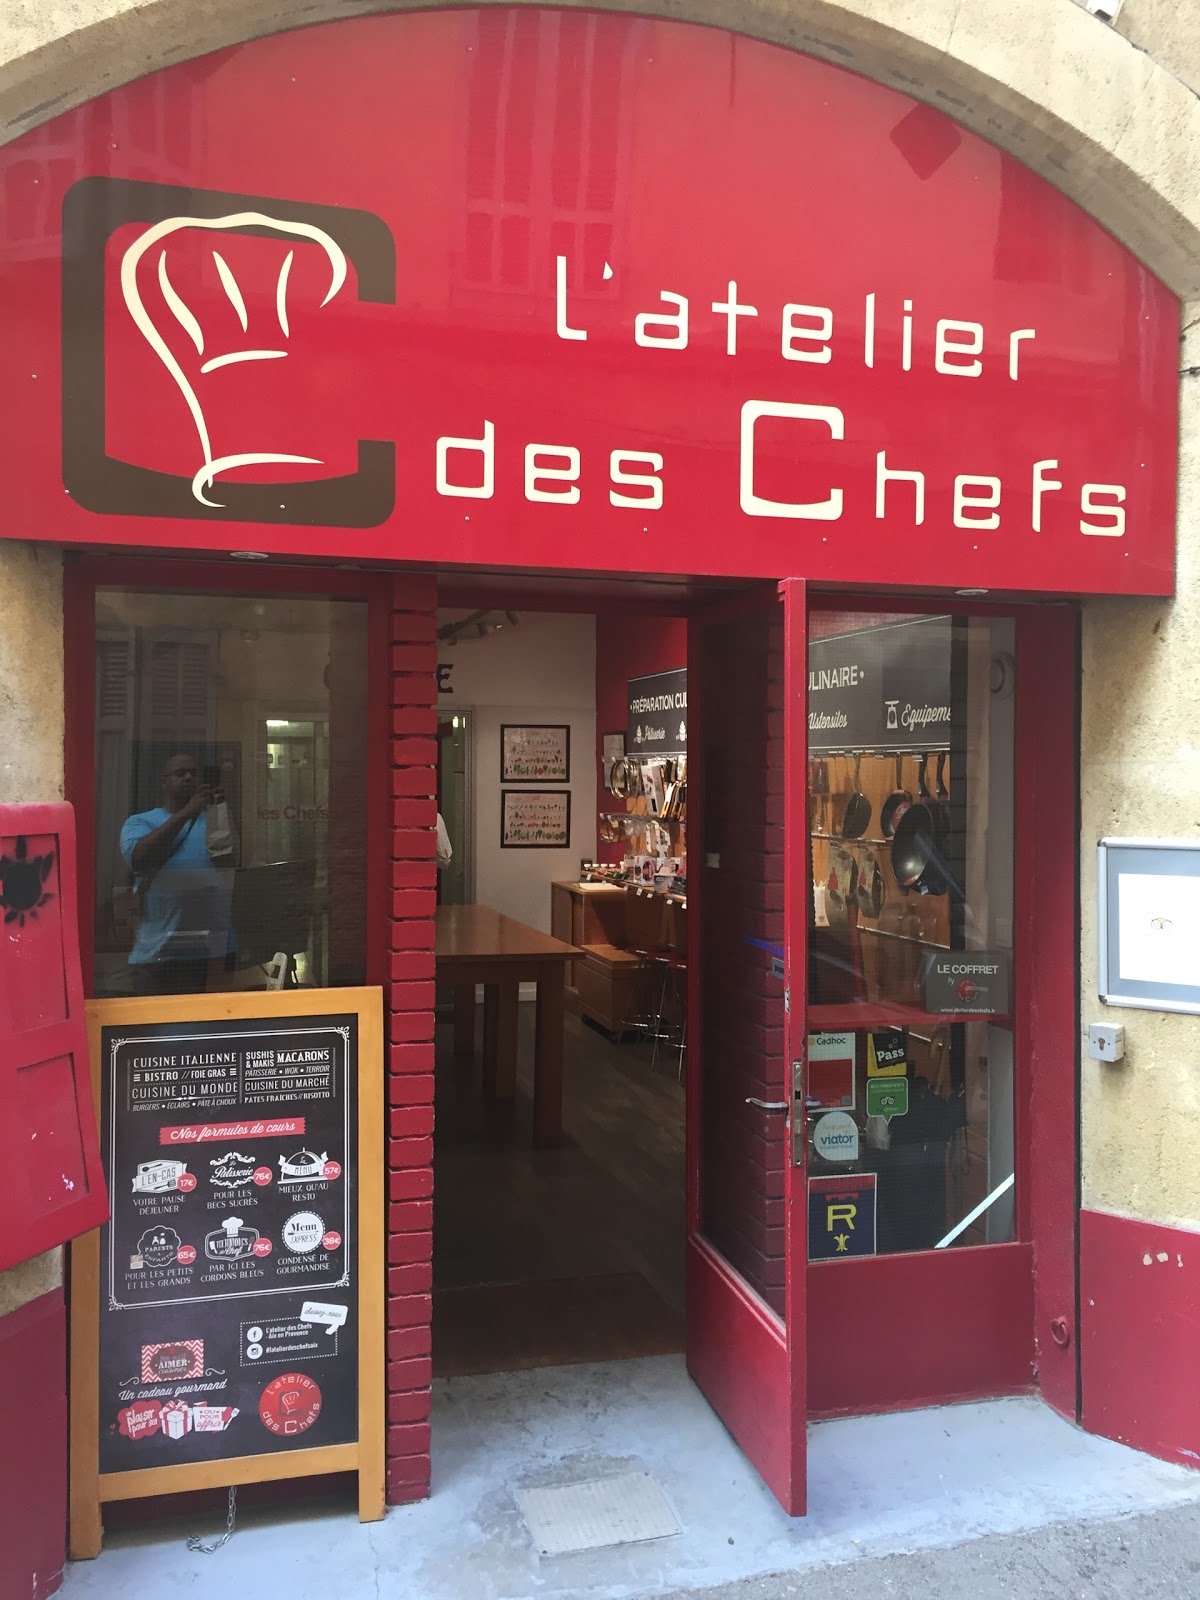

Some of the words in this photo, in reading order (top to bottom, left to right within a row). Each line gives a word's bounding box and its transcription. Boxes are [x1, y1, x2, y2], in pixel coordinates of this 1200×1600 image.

[556, 255, 1036, 381] L'atelier
[436, 419, 664, 510] des
[740, 399, 1127, 537] Chefs
[632, 695, 674, 713] PRÉPARATION
[937, 964, 950, 974] LE
[951, 964, 999, 975] COFFRET
[816, 1037, 846, 1046] Cadhoc
[133, 1056, 177, 1068] CUISINE
[181, 1052, 237, 1066] ITALIENNE
[245, 1050, 275, 1060] SUSHIS
[276, 1050, 330, 1064] MACARONS
[876, 1048, 905, 1062] Pass
[246, 1060, 251, 1069] &
[252, 1059, 275, 1068] MAKIS
[284, 1066, 299, 1075] WOK
[305, 1064, 330, 1074] TERROIR
[144, 1071, 179, 1082] BISTRO
[190, 1069, 206, 1079] FOIE
[207, 1068, 226, 1078] GRAS
[244, 1080, 279, 1092] CUISINE
[281, 1080, 293, 1089] DU
[296, 1076, 330, 1088] MARCHÉ
[132, 1086, 177, 1099] CUISINE
[181, 1084, 196, 1096] DU
[200, 1082, 238, 1095] MONDE
[303, 1091, 330, 1100] RISOTTO
[132, 1103, 160, 1112] BURGERS
[216, 1098, 237, 1106] CHOUX
[170, 1127, 197, 1140] Nos
[196, 1124, 249, 1142] formules
[250, 1122, 264, 1134] de
[266, 1122, 296, 1133] cours
[820, 1134, 854, 1145] viator
[255, 1172, 271, 1180] 76€
[324, 1166, 339, 1174] 57€
[142, 1167, 176, 1186] L'EN-CAS
[180, 1179, 194, 1187] 17€
[278, 1184, 302, 1194] MIEUX
[306, 1182, 329, 1192] QU'AU
[132, 1198, 158, 1206] VOTRE
[161, 1195, 186, 1204] PAUSE
[213, 1190, 234, 1200] POUR
[237, 1190, 252, 1198] LES
[292, 1193, 316, 1202] RESTO
[139, 1204, 180, 1216] DÉJEUNER
[207, 1200, 226, 1210] BECS
[827, 1204, 857, 1232] R
[291, 1223, 317, 1232] Menu
[291, 1234, 317, 1244] EXPRESS
[324, 1237, 340, 1245] 38€
[254, 1244, 270, 1252] 76€
[277, 1254, 317, 1266] CONDENSÉ
[320, 1253, 330, 1261] DE
[209, 1264, 225, 1272] PAR
[228, 1262, 238, 1270] ICI
[241, 1261, 256, 1269] LES
[276, 1262, 331, 1275] GOURMANDISE
[124, 1272, 146, 1281] POUR
[150, 1270, 164, 1278] LES
[167, 1267, 194, 1277] PETITS
[200, 1272, 237, 1283] CORDONS
[240, 1269, 264, 1279] BLEUS
[127, 1282, 137, 1290] ET
[140, 1280, 155, 1289] LES
[157, 1277, 191, 1287] GRANDS
[285, 1330, 309, 1338] Provence
[158, 1359, 188, 1370] AIMER
[118, 1390, 136, 1400] Un
[137, 1386, 173, 1398] cadeau
[173, 1378, 228, 1398] gourmand
[126, 1409, 155, 1433] plaisir
[262, 1411, 280, 1432] des
[284, 1402, 320, 1434] Chefs
[131, 1423, 148, 1438] pour
[148, 1417, 158, 1427] soi
